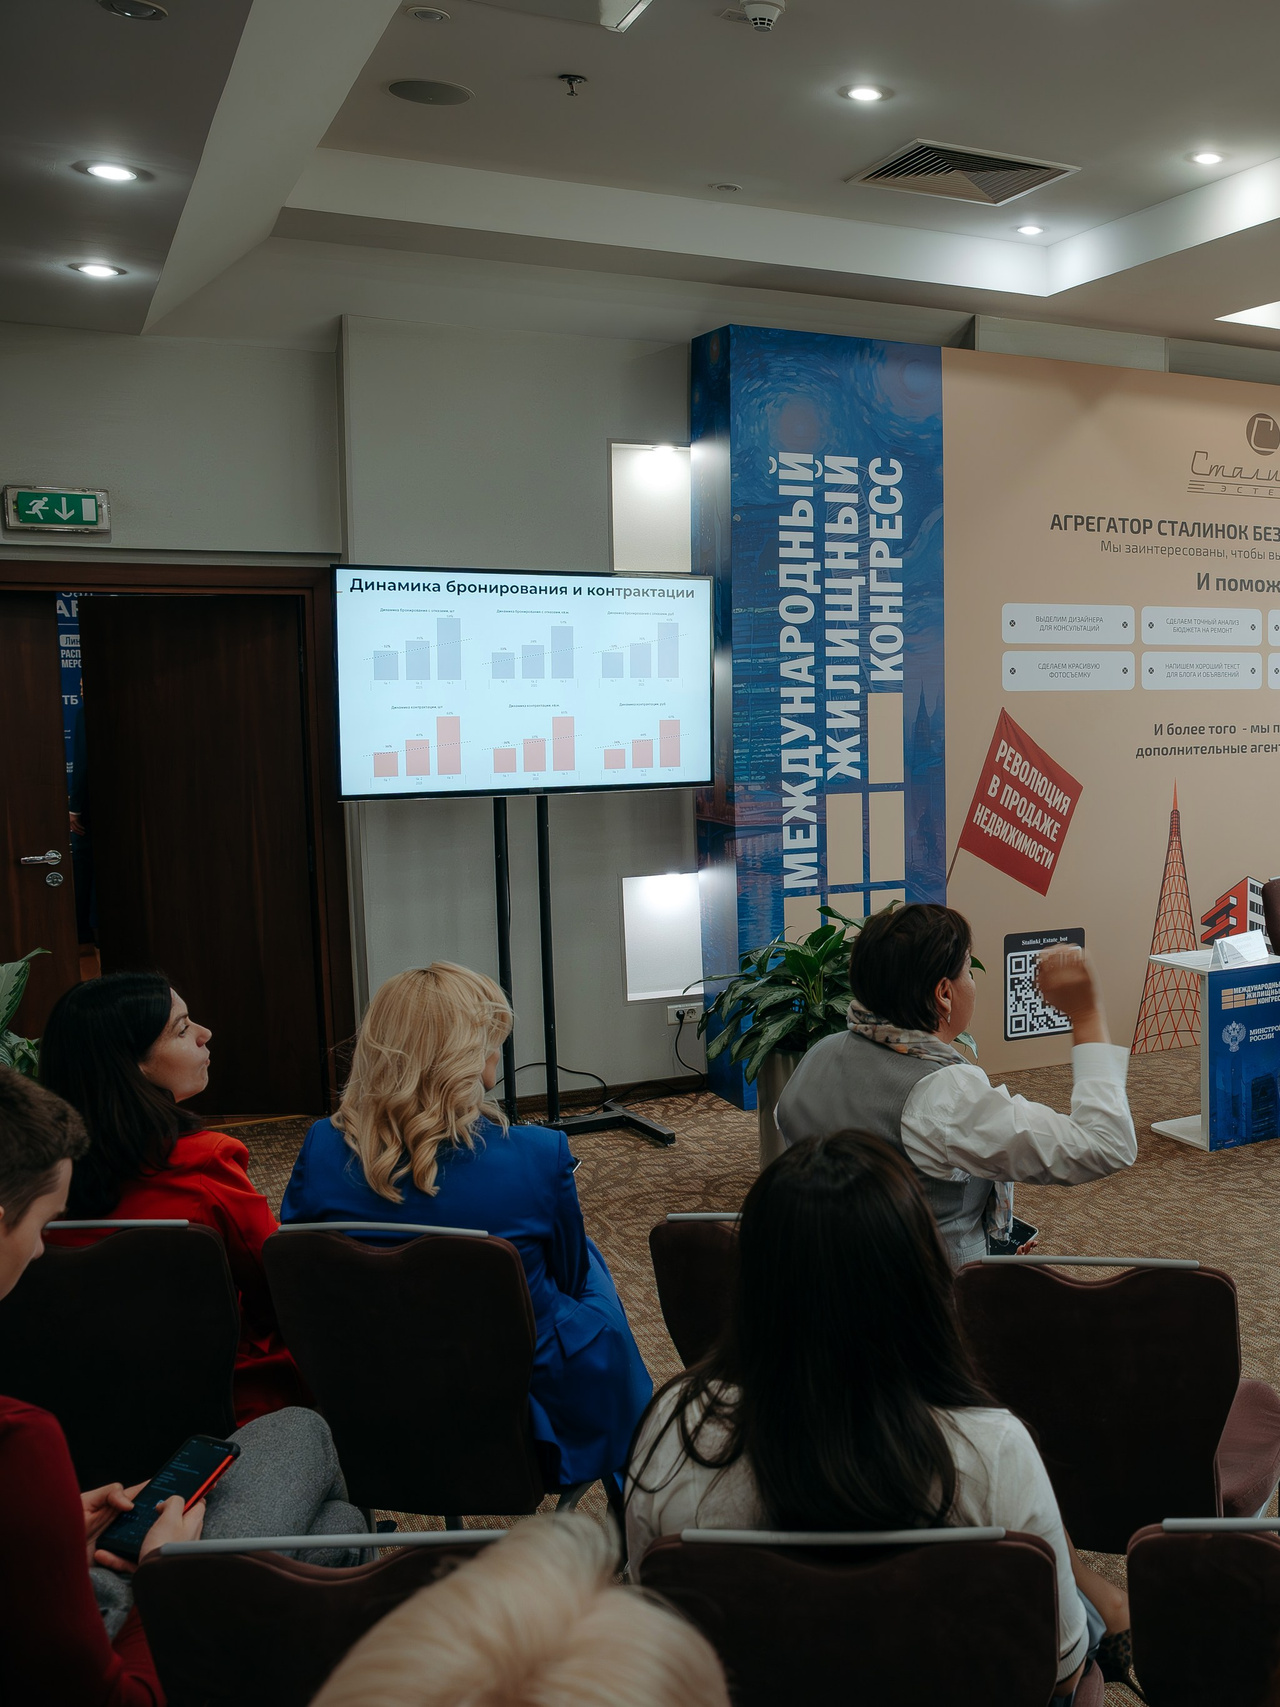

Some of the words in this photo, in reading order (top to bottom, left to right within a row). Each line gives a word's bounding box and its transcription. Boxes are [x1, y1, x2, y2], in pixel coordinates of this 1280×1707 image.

[1050, 513, 1153, 535] АГРЕГАТОР
[1157, 519, 1249, 541] СТАЛИНОК
[1100, 540, 1122, 553] Мы
[1125, 543, 1228, 560] заинтересованы,
[1230, 548, 1266, 561] чтобы
[868, 457, 905, 681] КОНГРЕСС
[350, 577, 441, 593] Динамика
[446, 578, 568, 598] бронирования
[573, 584, 583, 596] и
[587, 585, 695, 600] контрактации
[1197, 572, 1210, 591] И
[814, 454, 866, 780] ЖИЛИЩНЫЙ
[1035, 615, 1067, 623] ВЫДЕЛИМ
[1068, 616, 1104, 624] ДИЗАЙНЕРА
[1039, 624, 1053, 632] ДЛЯ
[1053, 624, 1100, 633] КОНСУЛЬТАЦИЙ
[768, 451, 822, 889] МЕЖДУНАРОДНЫЙ
[1153, 724, 1163, 736] И
[1166, 722, 1206, 736] более
[1208, 724, 1237, 735] того
[1250, 723, 1270, 734] мы
[1135, 742, 1248, 759] дополнительные
[995, 738, 1071, 817] РЕВОЛЮЦИЯ
[987, 773, 1001, 798] В
[1000, 783, 1061, 843] ПРОДАЖЕ
[972, 801, 1055, 870] НЕДВИЖИМОСТИ
[1250, 1033, 1274, 1042] РОССИИ
